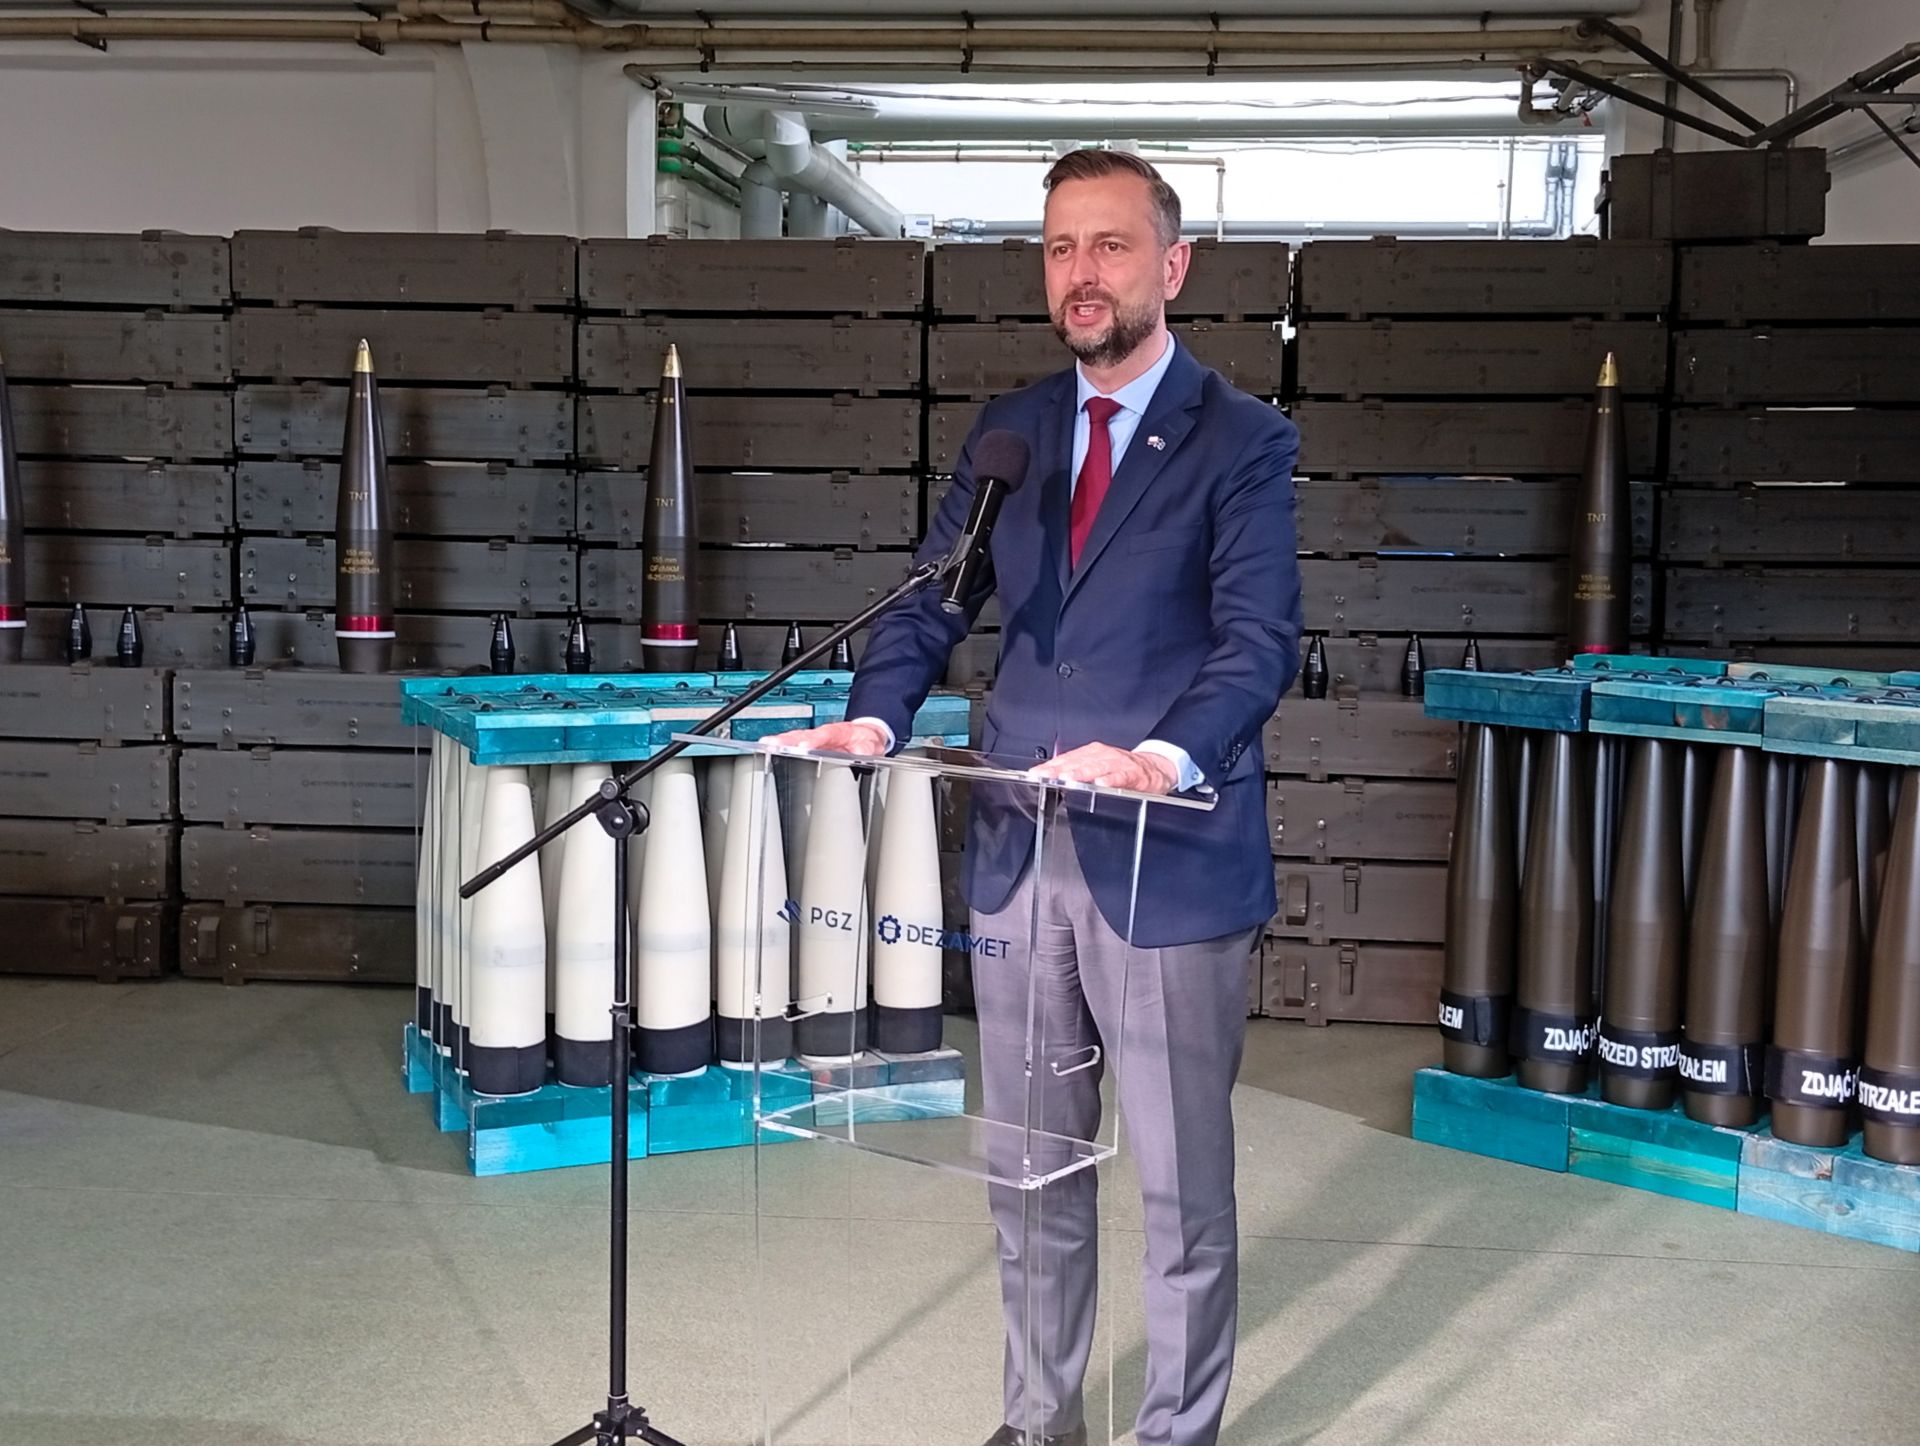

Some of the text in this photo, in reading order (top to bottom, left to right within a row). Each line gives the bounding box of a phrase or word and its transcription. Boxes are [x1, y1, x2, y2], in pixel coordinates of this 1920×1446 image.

[349, 491, 369, 500] TNT
[655, 497, 674, 507] TNT
[1587, 512, 1608, 522] TNT
[811, 907, 852, 931] PGZ
[907, 924, 1011, 959] DEZAMET
[1543, 1023, 1589, 1055] ZDJĄĆ
[1598, 1034, 1637, 1067] PRZED
[1801, 1069, 1851, 1103] ZDJĄĆ
